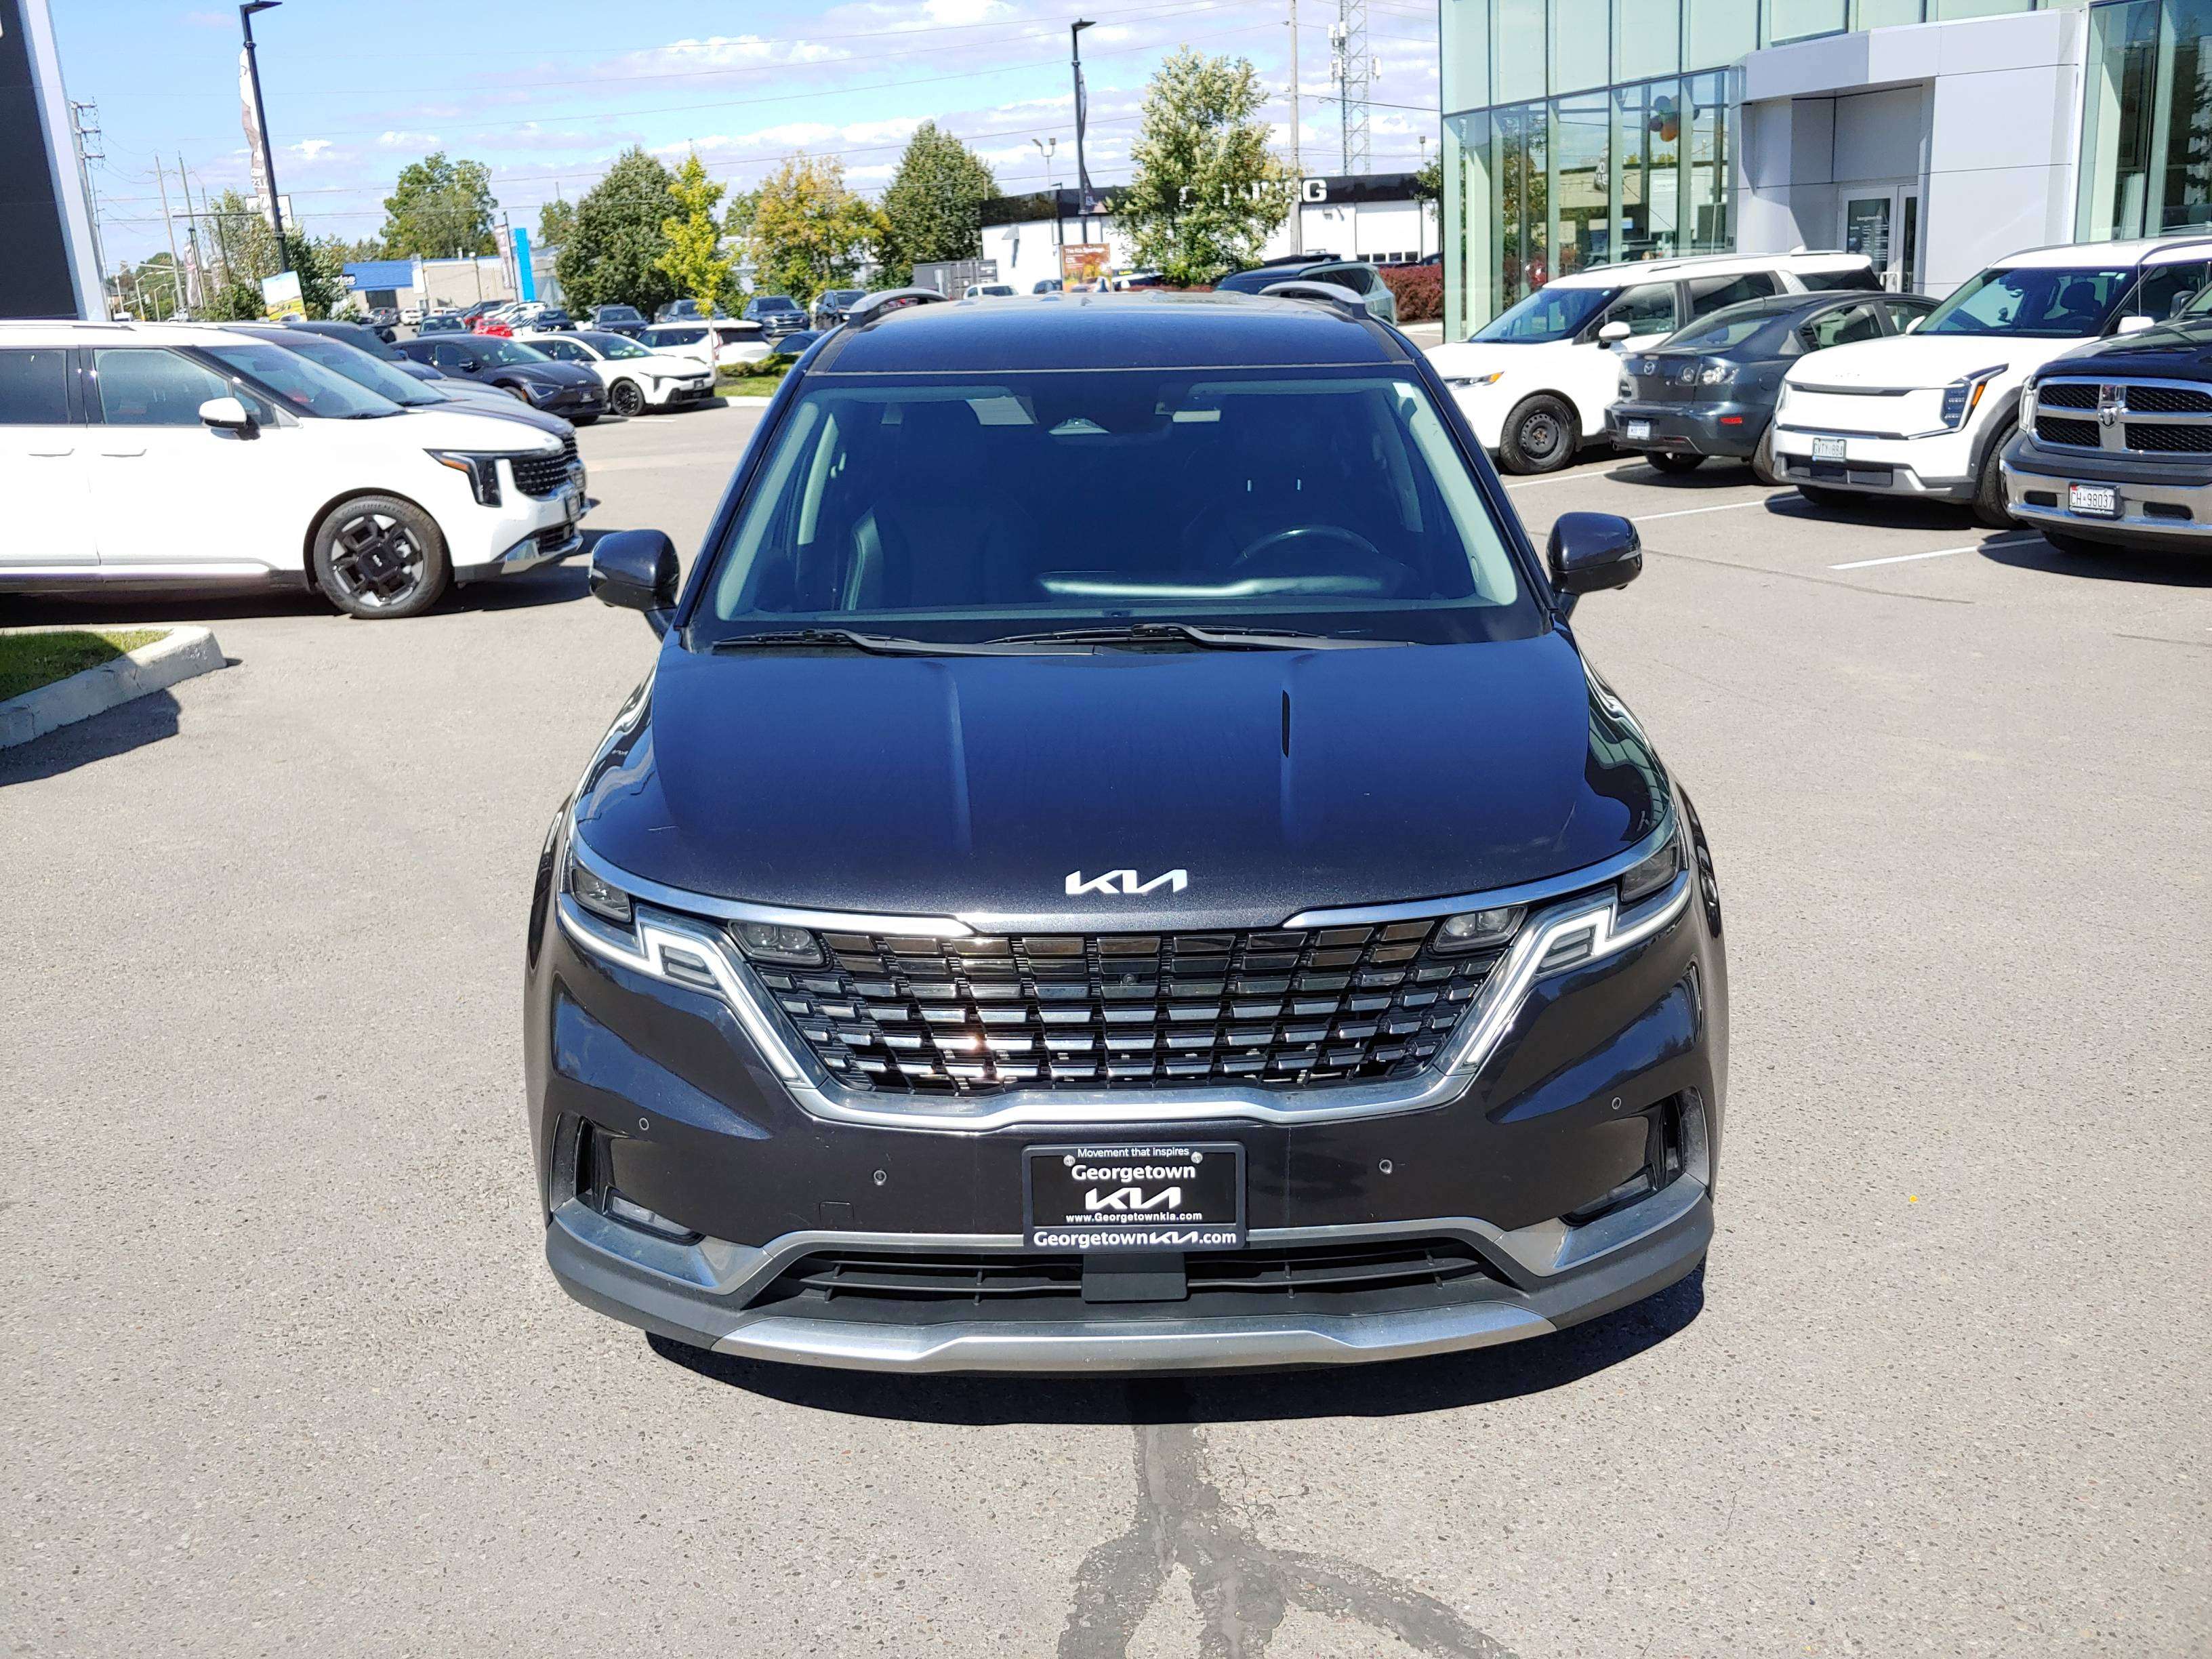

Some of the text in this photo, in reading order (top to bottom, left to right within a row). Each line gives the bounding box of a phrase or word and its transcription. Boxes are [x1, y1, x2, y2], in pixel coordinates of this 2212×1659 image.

[2070, 491, 2114, 509] CH 98037
[1078, 1147, 1189, 1158] Movement that inspires
[1071, 1164, 1196, 1183] Georgetown
[1065, 1212, 1203, 1224] www.Georgetownkia.com
